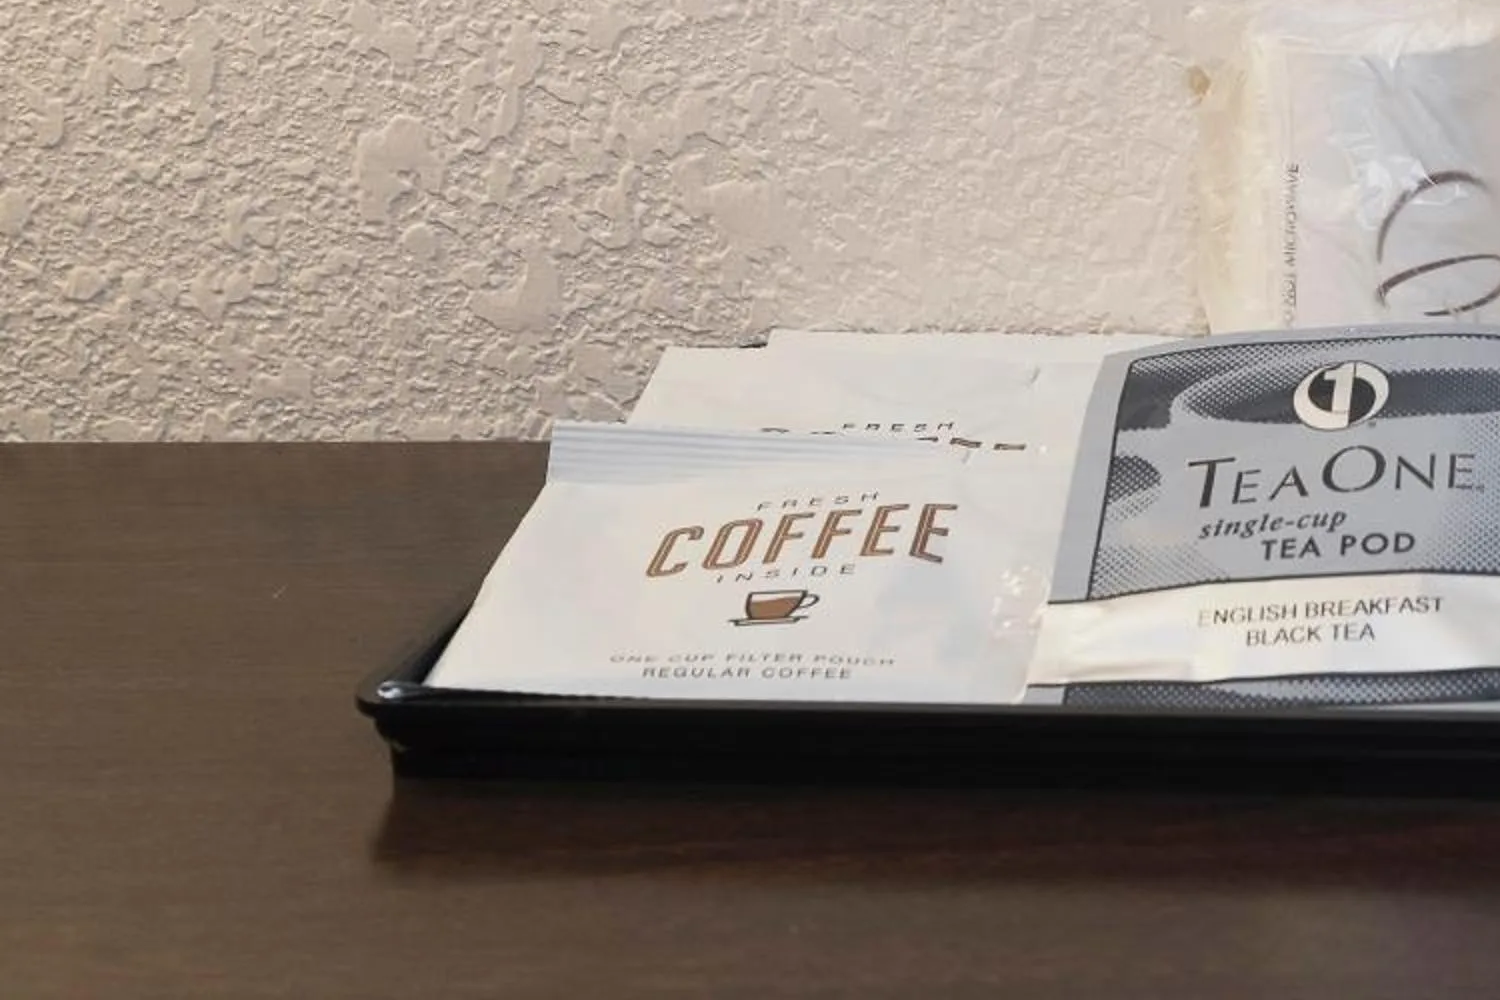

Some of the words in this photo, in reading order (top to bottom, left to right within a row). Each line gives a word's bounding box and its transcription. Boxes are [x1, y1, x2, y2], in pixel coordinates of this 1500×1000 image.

[843, 422, 953, 433] FRESH
[757, 491, 880, 511] FRESH
[1198, 510, 1347, 540] single-cup
[645, 503, 958, 577] COFFEE
[1261, 535, 1321, 561] TEA
[1340, 532, 1416, 556] POD
[716, 563, 857, 583] INSIDE
[1198, 603, 1298, 628] ENGLISH
[1305, 595, 1444, 619] BREAKFAST
[1246, 624, 1321, 647] BLACK
[1331, 622, 1375, 642] TEA
[609, 653, 659, 664] ONE
[667, 653, 715, 664] CUP
[725, 652, 803, 664] FILTER
[812, 654, 897, 667] POUCH
[641, 666, 751, 680] REGULAR
[761, 666, 854, 680] COFFEE
